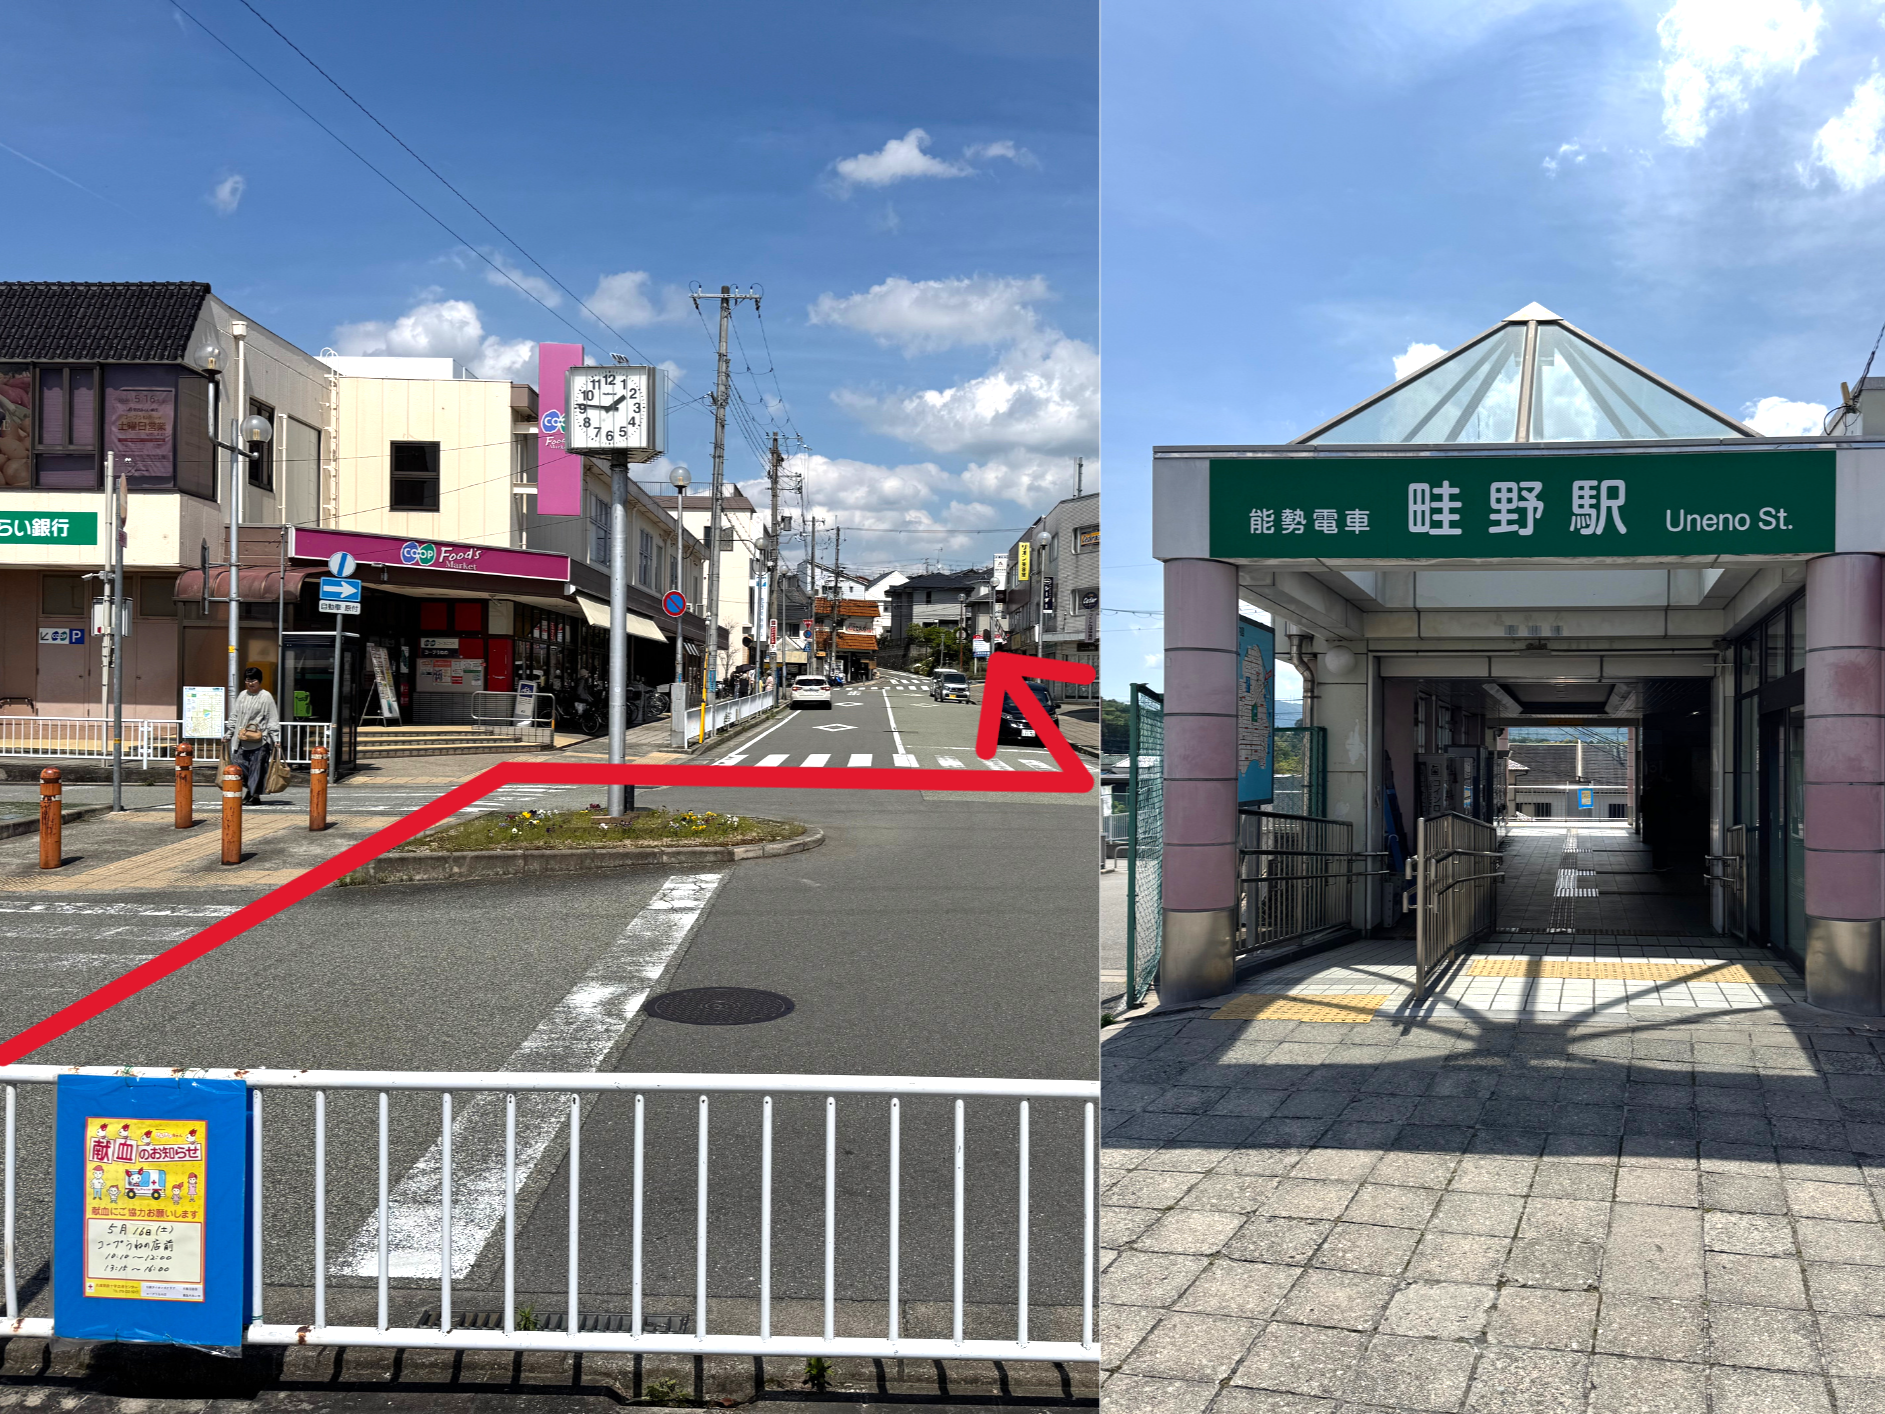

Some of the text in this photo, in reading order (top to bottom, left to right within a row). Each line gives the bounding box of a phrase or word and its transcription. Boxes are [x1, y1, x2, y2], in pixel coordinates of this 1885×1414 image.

[590, 379, 600, 390] 11
[602, 374, 616, 385] 12
[621, 379, 626, 389] 1
[581, 390, 594, 401] 10
[629, 388, 637, 399] 2
[579, 404, 587, 414] 9
[633, 402, 641, 413] 3
[118, 421, 167, 431] 土曜日営業
[583, 417, 591, 428] 8
[628, 417, 636, 427] 4
[593, 427, 602, 438] 7
[606, 430, 614, 442] 6
[618, 427, 627, 438] 5
[1249, 479, 1793, 536] 能勢電車 畦野駅 Uneno St.
[0, 518, 69, 537] らい銀行
[404, 547, 483, 563] COOP Food's
[446, 560, 477, 571] Market
[72, 631, 81, 642] P
[92, 1140, 200, 1162] 献血のお知らせ
[92, 1206, 199, 1220] 献血にご協力お願いします
[97, 1239, 174, 1252] コープうねの店前
